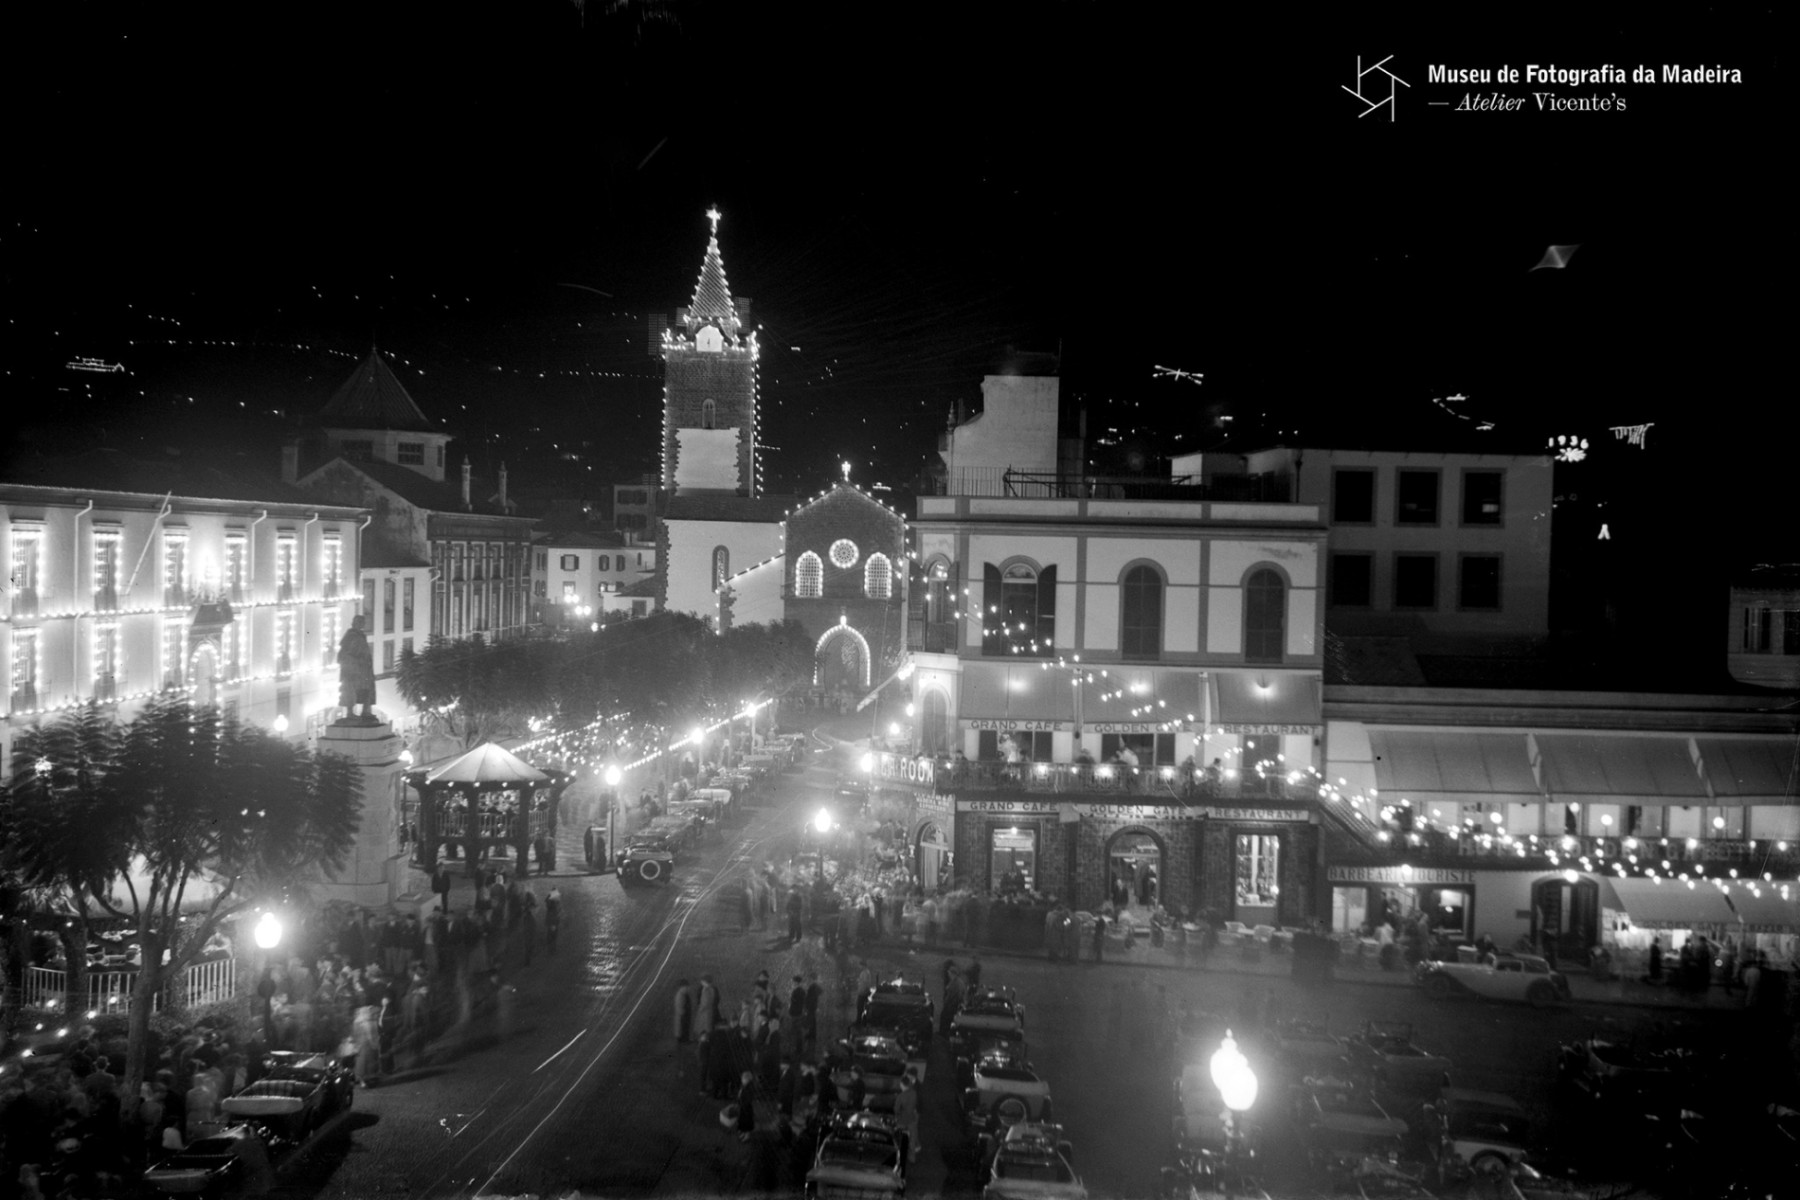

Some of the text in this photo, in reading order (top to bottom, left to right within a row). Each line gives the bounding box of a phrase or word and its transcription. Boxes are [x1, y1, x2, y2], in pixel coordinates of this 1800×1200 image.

[970, 720, 1018, 730] GRAND
[1094, 724, 1149, 733] GOLDEN
[1224, 725, 1318, 735] RESTAURANT
[900, 757, 934, 782] ROOM
[970, 801, 1015, 810] GRAND
[1089, 804, 1187, 817] GOLDEN GATE
[1214, 808, 1301, 819] RESTAURANT
